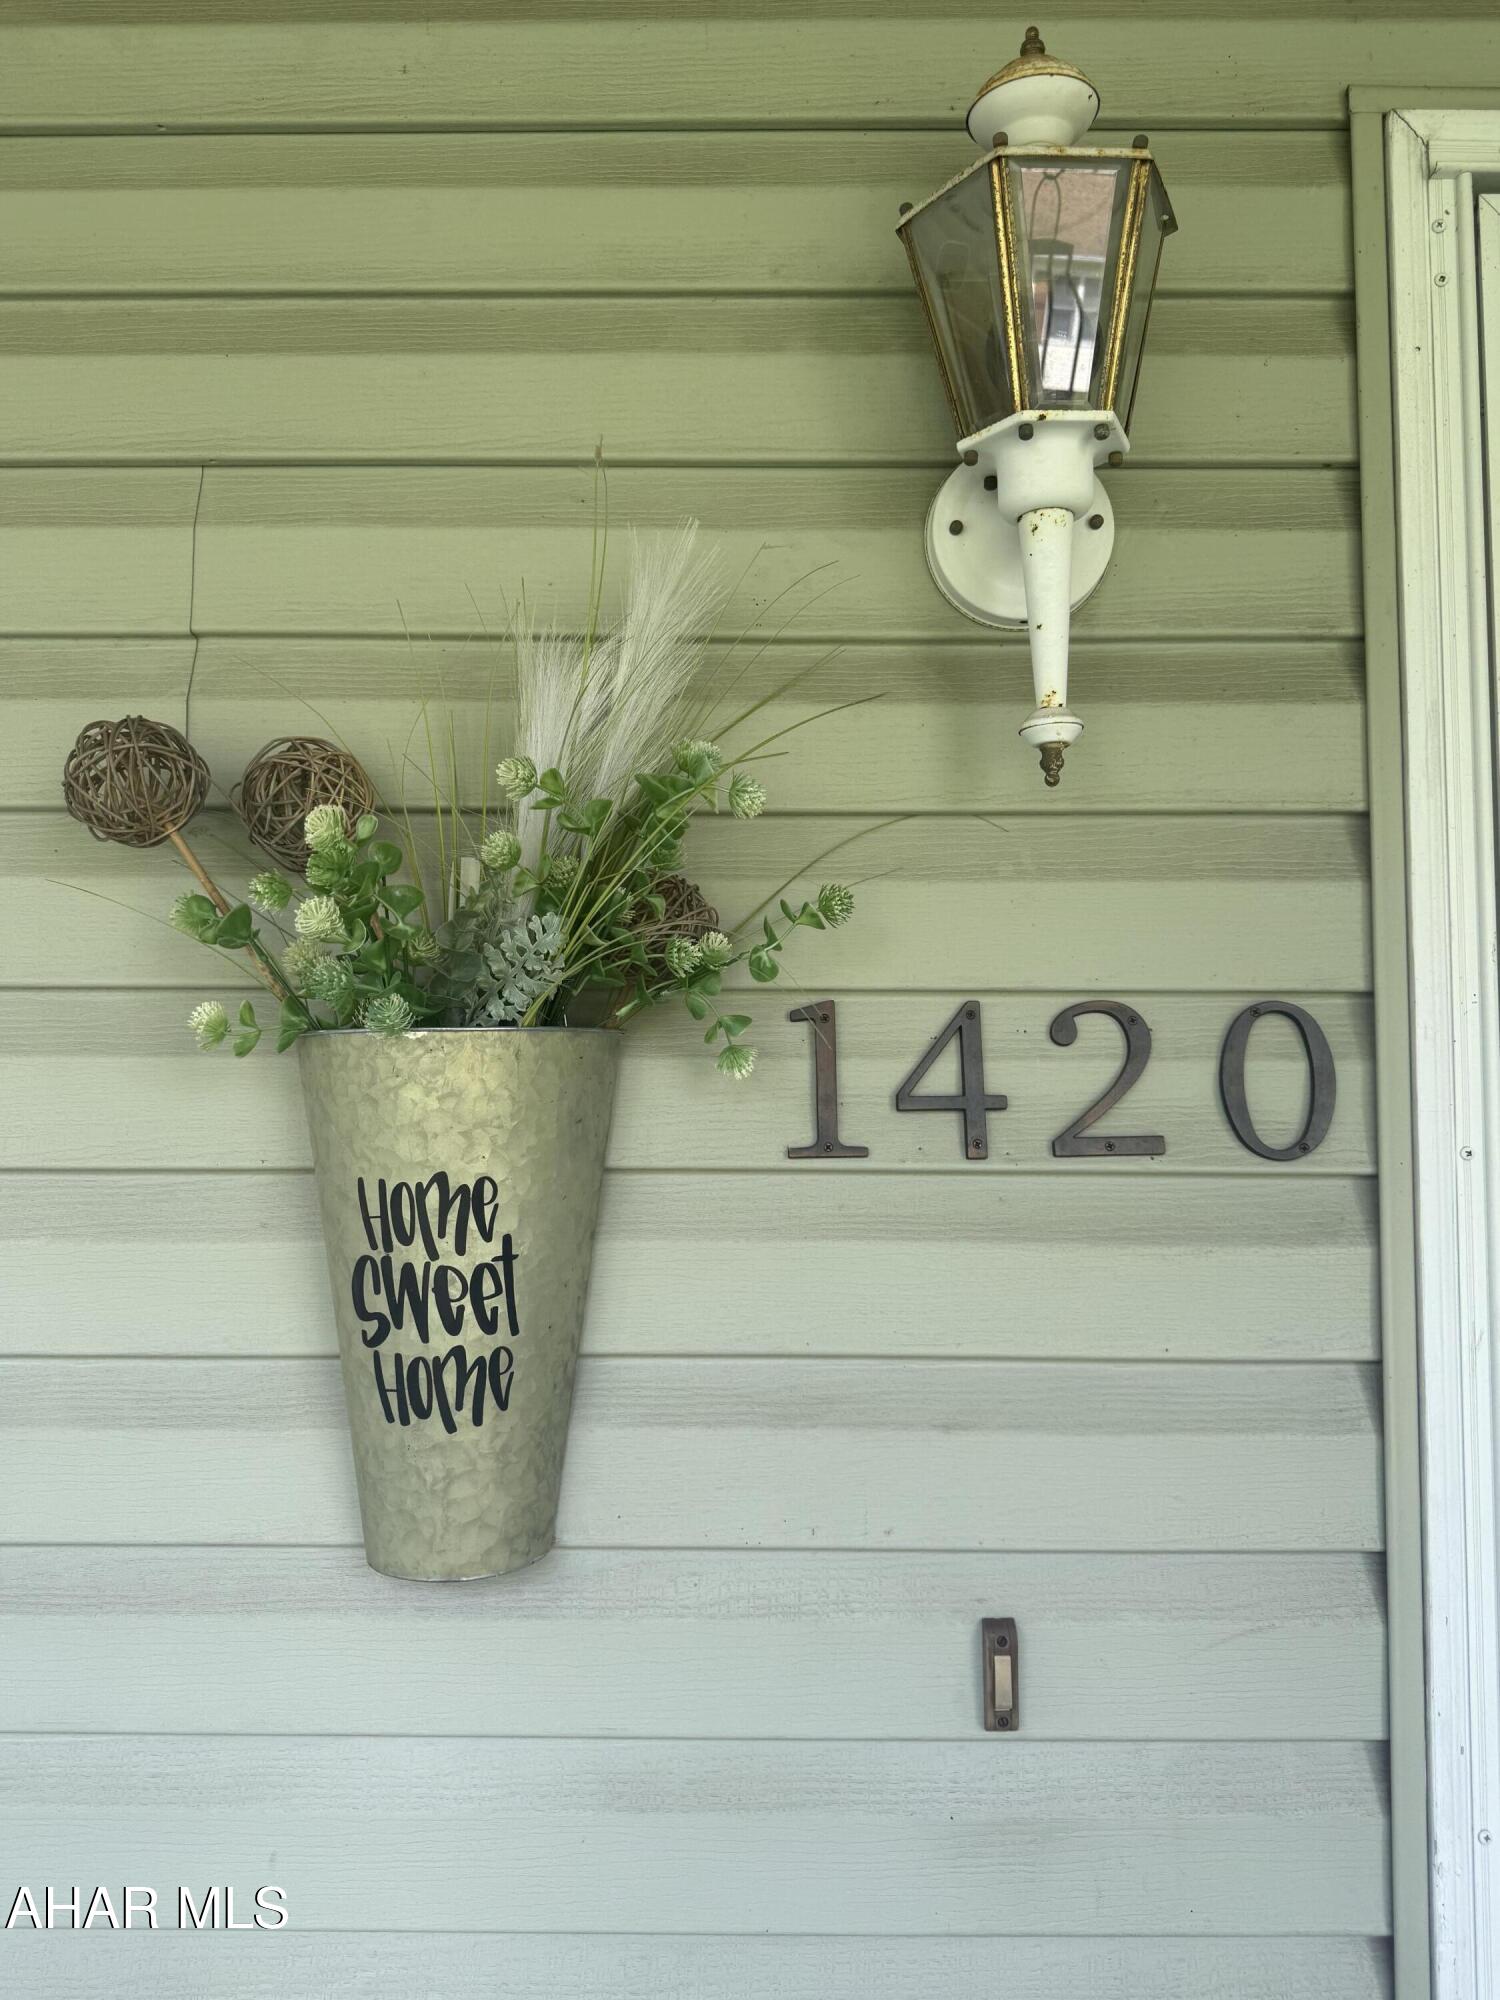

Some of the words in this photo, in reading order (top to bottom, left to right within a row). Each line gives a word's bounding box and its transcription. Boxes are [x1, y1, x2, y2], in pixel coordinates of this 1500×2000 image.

[788, 1000, 1337, 1161] 1420
[357, 1170, 499, 1262] Home
[373, 1344, 515, 1435] Home
